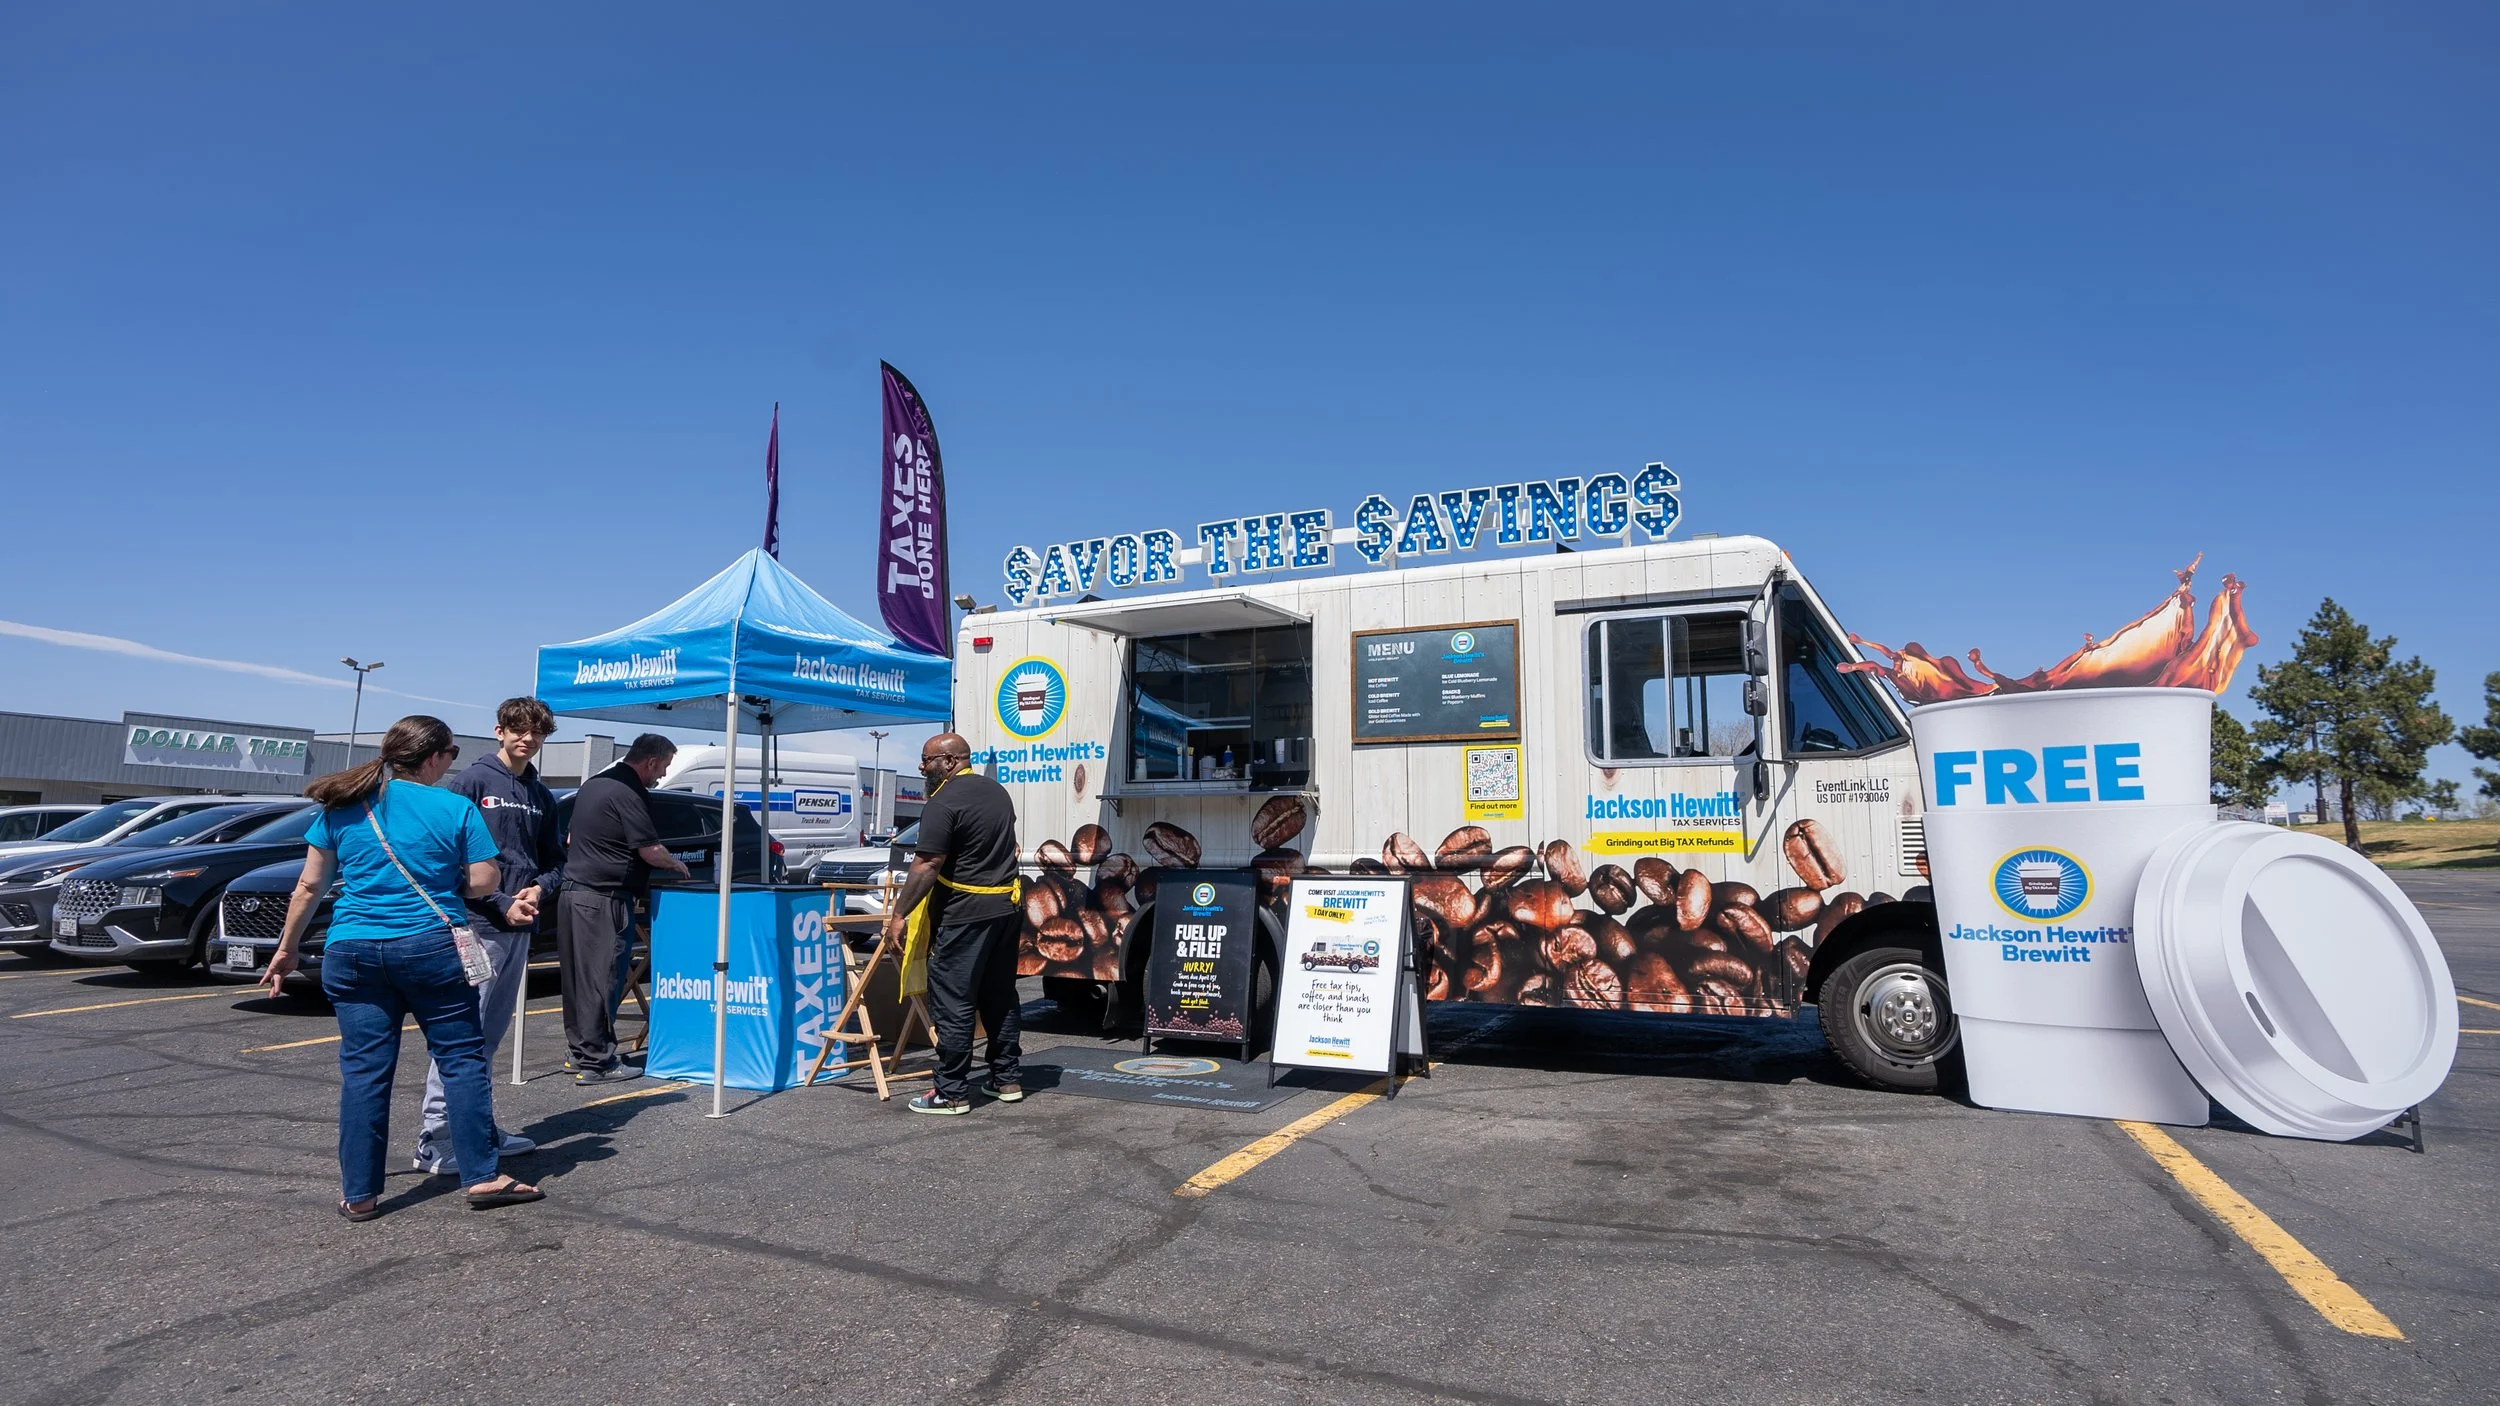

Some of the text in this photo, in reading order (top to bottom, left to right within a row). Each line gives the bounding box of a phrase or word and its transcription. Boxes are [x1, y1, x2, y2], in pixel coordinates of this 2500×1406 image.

[887, 432, 921, 594] TAXES
[1197, 508, 1335, 577] THE
[917, 522, 934, 599] DONE
[1368, 641, 1415, 656] MENU
[574, 658, 630, 685] Jackson
[792, 652, 906, 694] Jackson Hewitt
[624, 677, 674, 690] TAX SERVICES
[856, 688, 906, 703] TAX SERVICES
[129, 728, 308, 758] DOLLAR TREE
[970, 741, 1105, 765] ackson Hewitt's
[998, 764, 1062, 784] Brewitt
[1934, 742, 2145, 806] FREE
[1816, 778, 1889, 792] EventLink LLC
[798, 798, 837, 808] PENSKE
[1817, 792, 1889, 803] US DOT #1930069
[481, 796, 544, 816] Champin
[1586, 792, 1740, 819] Jackson Hewitt
[1693, 818, 1740, 826] SERVICES
[1606, 838, 1642, 848] Grinding
[1660, 838, 1675, 848] Big
[1676, 838, 1695, 846] TAX
[1696, 838, 1734, 846] Refunds
[1323, 897, 1368, 909] BREWITT
[1328, 910, 1345, 919] ONLY!
[1175, 924, 1227, 941] FUEL UP
[1948, 923, 2133, 944] Jackson Hewitt'
[1176, 941, 1221, 959] & FILE!
[2002, 944, 2090, 962] Brewitt
[1183, 962, 1214, 973] HURRY!
[655, 972, 711, 1000] Jackson
[1188, 982, 1197, 990] free
[1312, 979, 1361, 994] Free tax tips,
[793, 910, 824, 1082] TAXES
[1302, 990, 1369, 1004] coffee, and snacks
[726, 1005, 768, 1017] SERVICES
[1313, 1002, 1333, 1011] closer
[1336, 1003, 1354, 1012] than
[1357, 1008, 1371, 1017] you
[1323, 1013, 1343, 1023] think
[1309, 1035, 1350, 1045] Jackson Hewitt
